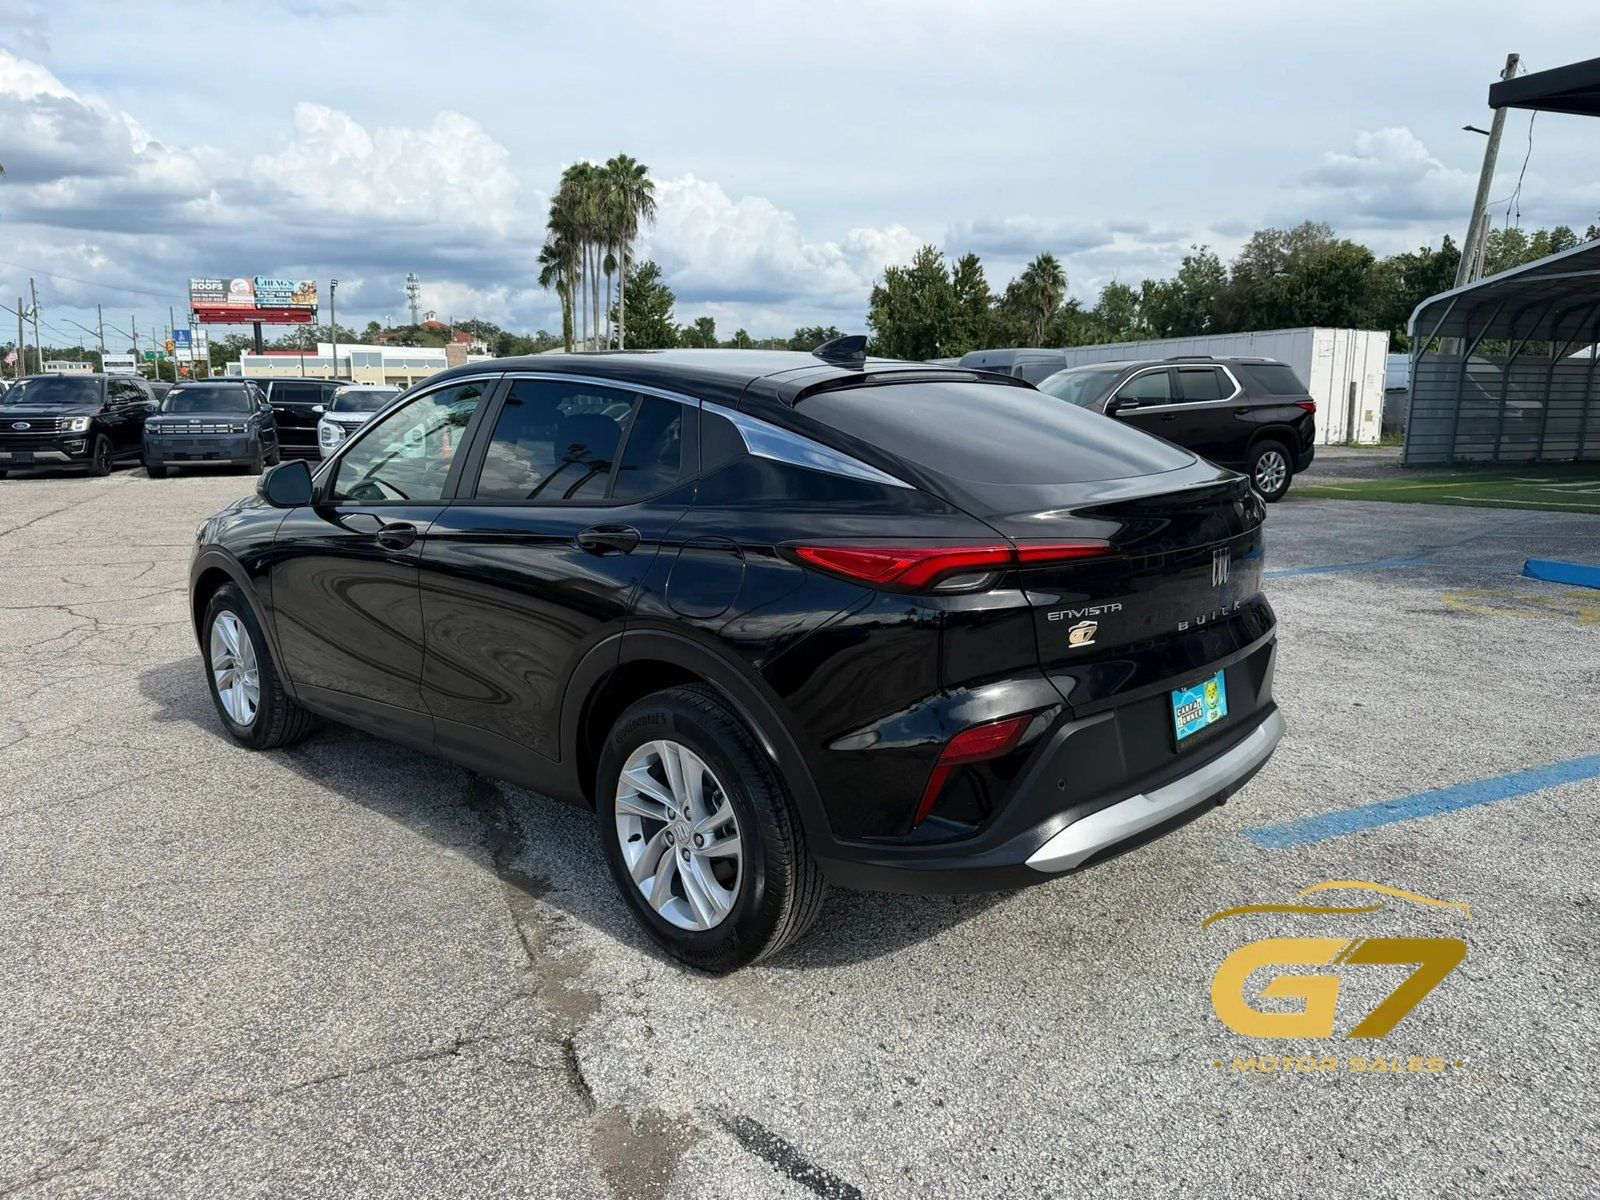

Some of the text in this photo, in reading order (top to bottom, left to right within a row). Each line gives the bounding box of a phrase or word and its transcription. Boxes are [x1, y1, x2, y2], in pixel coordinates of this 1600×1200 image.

[1047, 603, 1122, 621] ENVISTA
[1178, 601, 1240, 632] BUICK
[1182, 708, 1204, 725] OWNER
